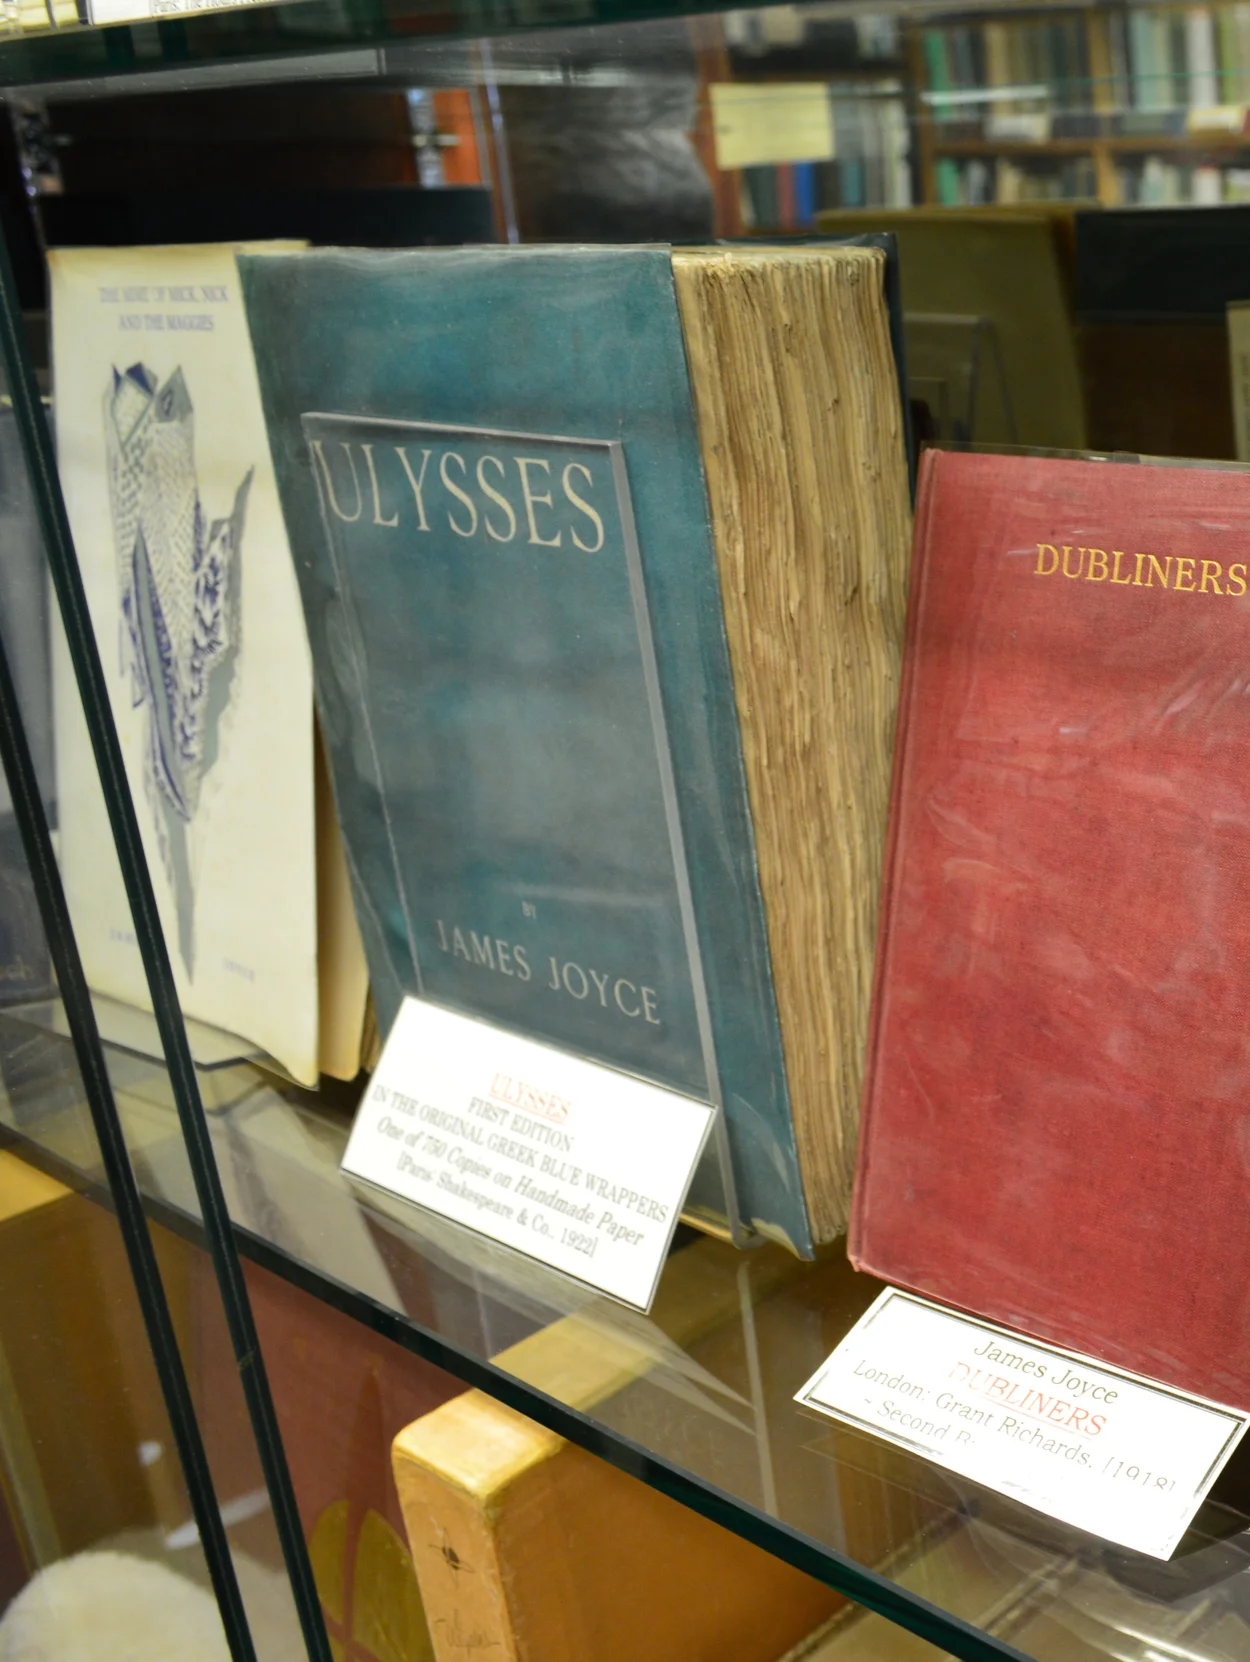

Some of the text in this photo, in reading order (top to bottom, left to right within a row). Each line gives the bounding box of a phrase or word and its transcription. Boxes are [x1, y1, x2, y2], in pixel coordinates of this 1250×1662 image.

[310, 440, 604, 552] ULYSSES
[1034, 543, 1248, 596] DUBLINERS
[521, 900, 537, 919] BY
[437, 919, 660, 1025] JAMES JOYCE
[372, 1084, 669, 1223] IN THE ORIGINAL GREEK BLUE WRAPPERS
[468, 1096, 575, 1152] FIRST EDITION
[377, 1116, 645, 1247] One of 750 Copies on Handmade Paper
[436, 1171, 514, 1219] Shakespeare
[516, 1207, 528, 1226] &
[853, 1359, 930, 1401] London:
[935, 1392, 994, 1427] Grant
[948, 1361, 1107, 1437] DUBLINERS
[973, 1341, 1119, 1405] James Joyce
[877, 1400, 951, 1440] Second
